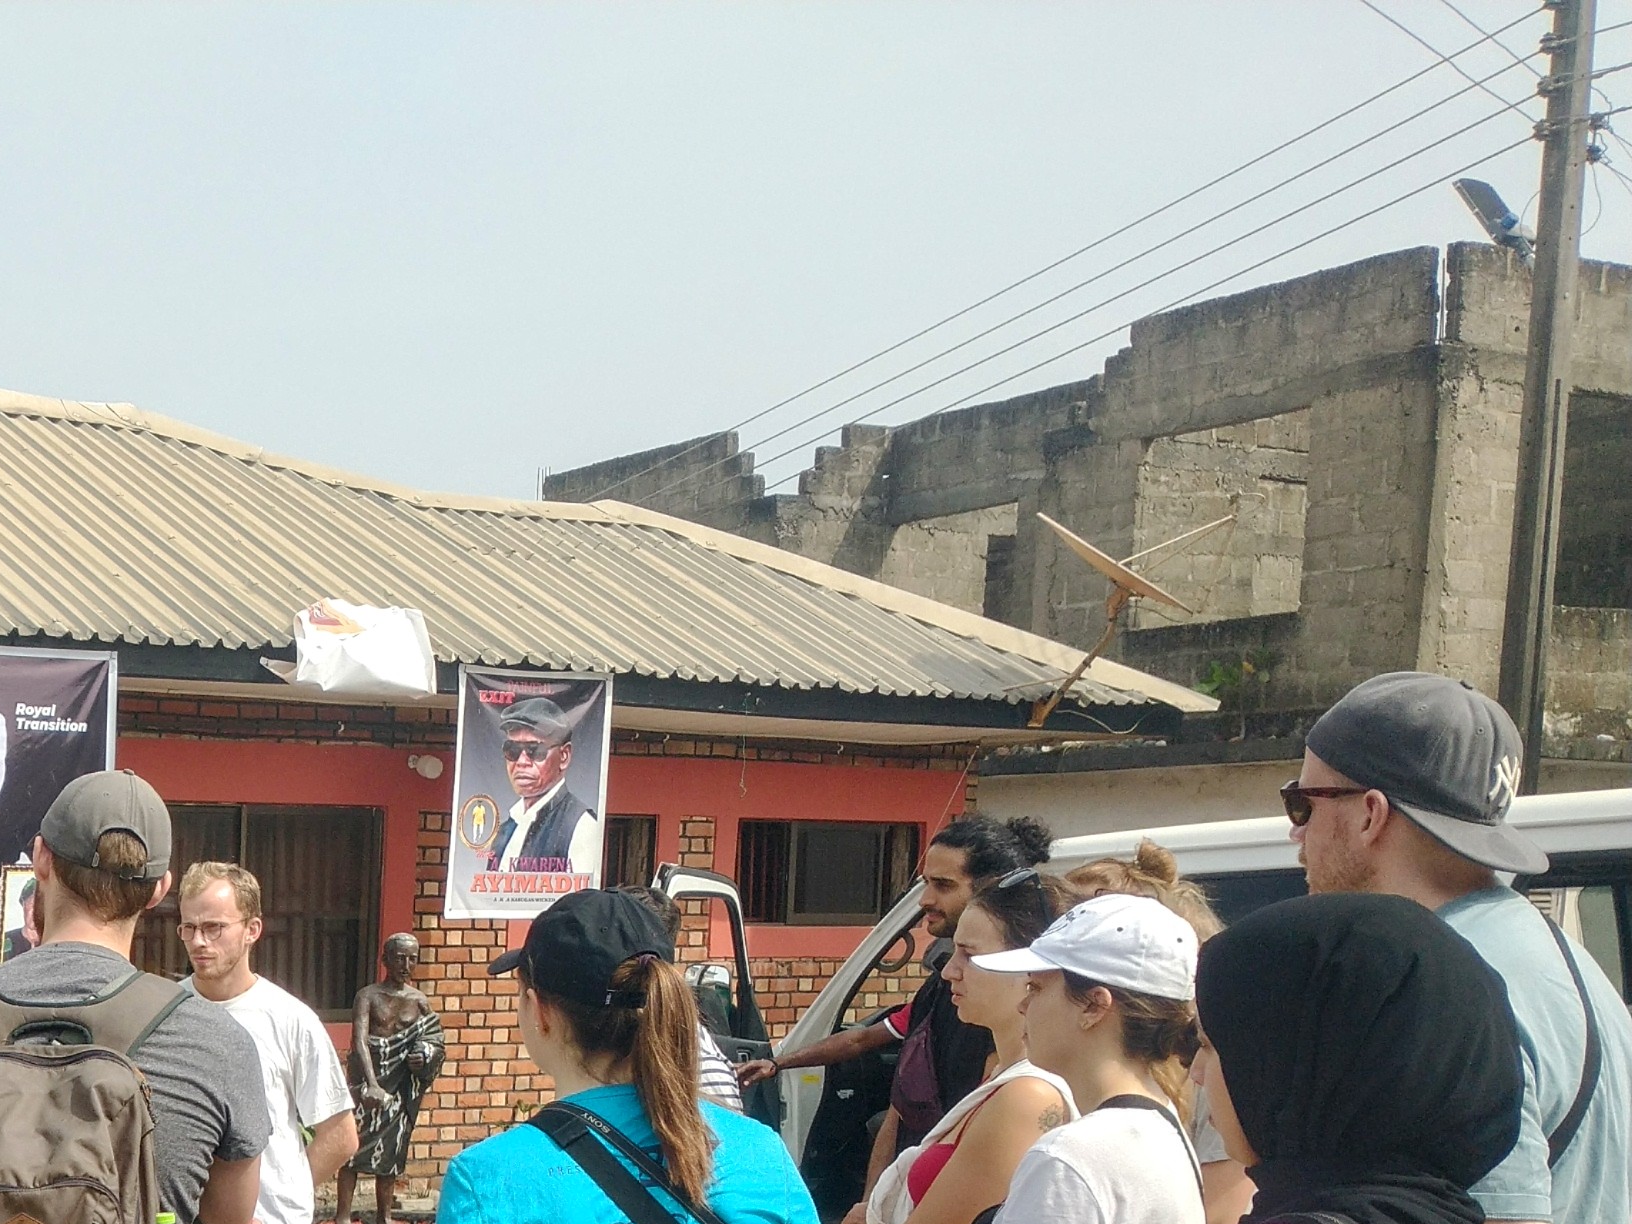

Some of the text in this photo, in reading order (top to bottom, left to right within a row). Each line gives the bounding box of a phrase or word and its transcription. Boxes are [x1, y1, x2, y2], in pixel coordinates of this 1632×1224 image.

[478, 689, 516, 704] EXIT
[15, 703, 57, 718] Royal
[16, 717, 88, 732] Transition
[470, 873, 590, 893] AYIMADU
[580, 1112, 611, 1134] SONY
